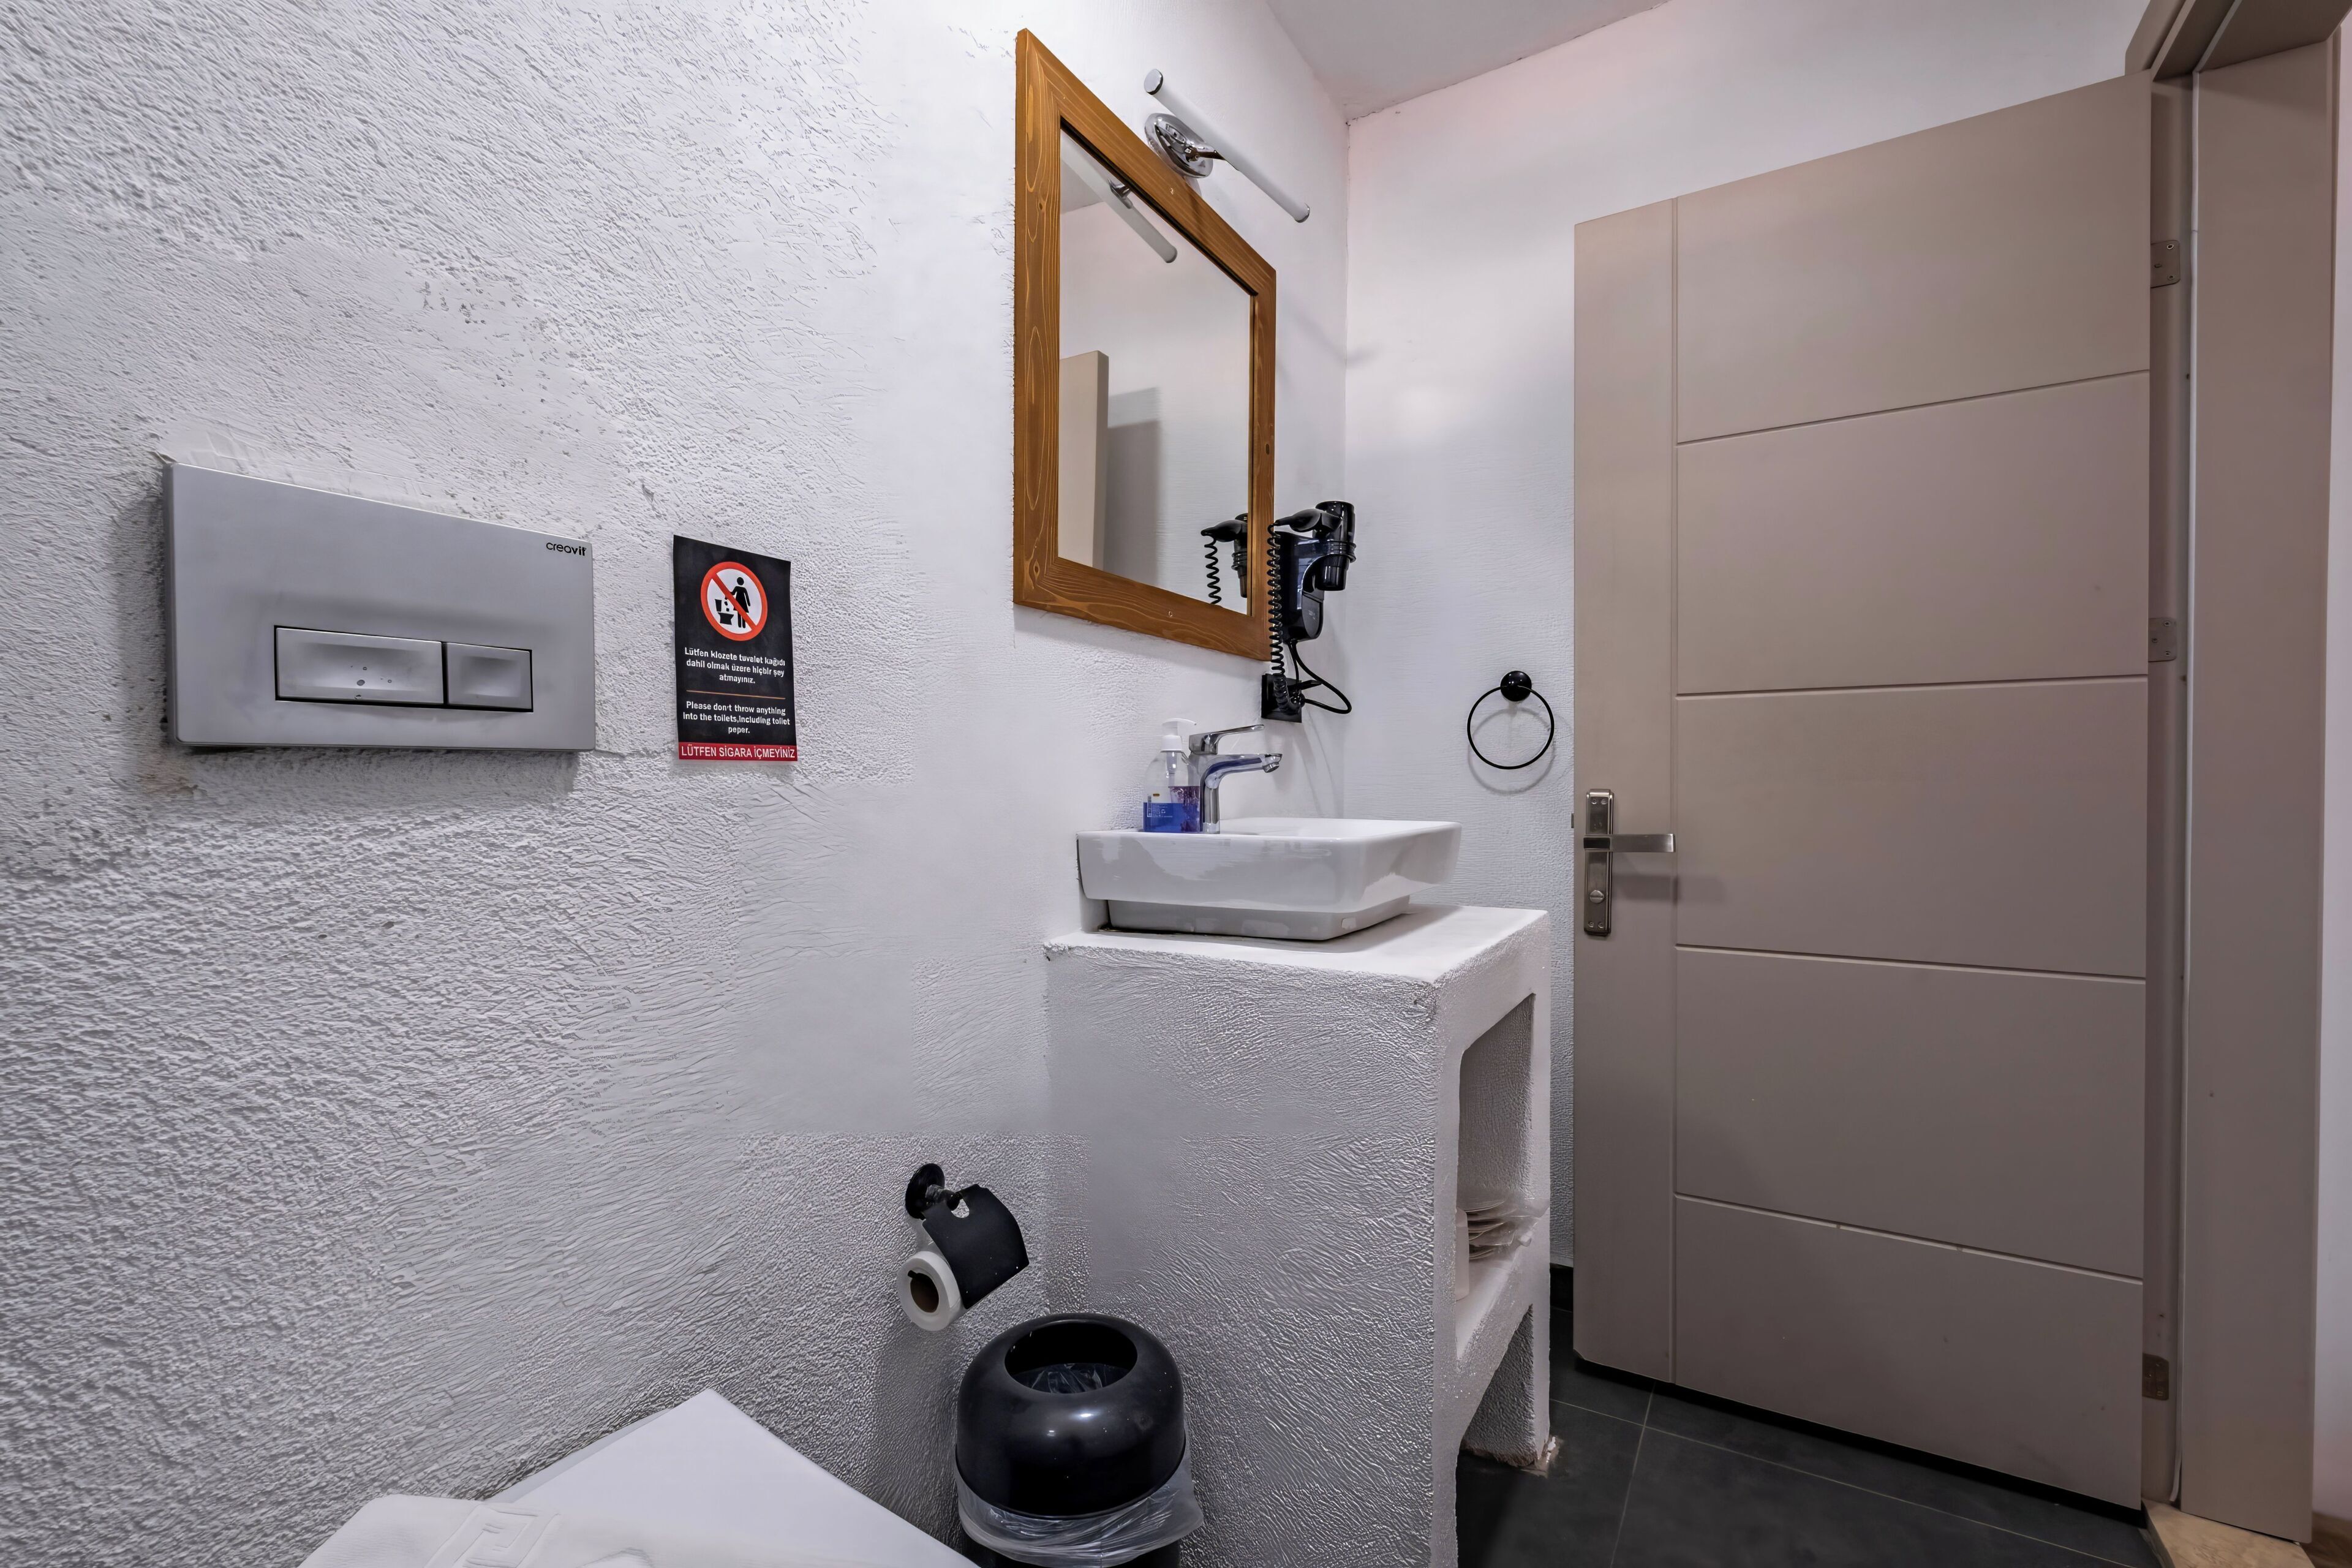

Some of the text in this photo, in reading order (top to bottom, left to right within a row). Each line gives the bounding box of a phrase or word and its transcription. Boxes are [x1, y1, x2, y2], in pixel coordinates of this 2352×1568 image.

[546, 543, 586, 556] creavit
[685, 647, 708, 657] Lütfen
[711, 651, 737, 660] klozete
[739, 654, 763, 663] tuvalet
[687, 659, 704, 668] dahil
[707, 662, 729, 671] olmak
[732, 664, 751, 673] üzere
[753, 666, 772, 675] hiçbir
[719, 674, 755, 684] atmayınız.
[687, 701, 711, 710] Please
[756, 707, 786, 715] anything
[681, 744, 795, 759] LÜTFEN SİGARA İÇMEYİNİZ
